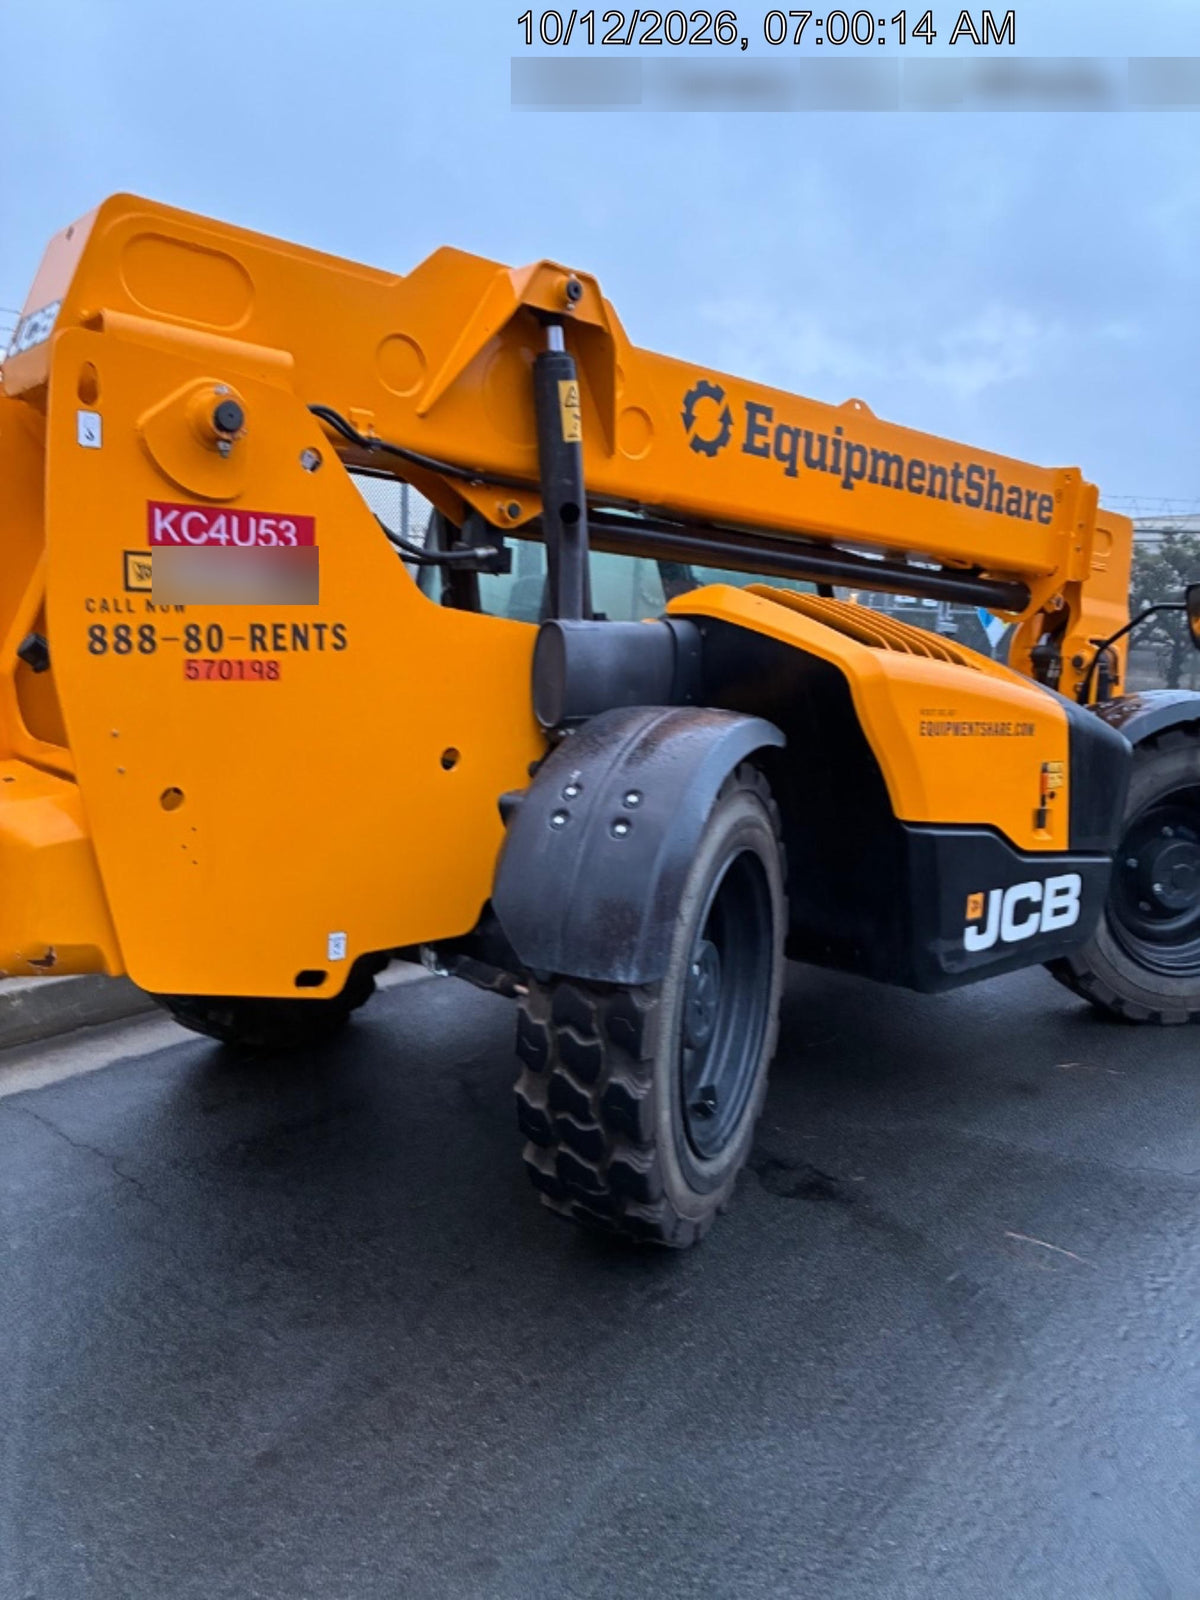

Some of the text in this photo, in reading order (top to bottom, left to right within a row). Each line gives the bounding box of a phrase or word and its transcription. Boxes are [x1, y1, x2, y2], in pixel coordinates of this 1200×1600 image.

[742, 400, 1054, 526] EquipmentShare
[153, 507, 298, 546] KC4U53
[85, 598, 135, 613] CALL
[88, 622, 348, 655] 888-80-RENTS
[185, 660, 280, 681] 570198
[964, 873, 1081, 951] JCB
